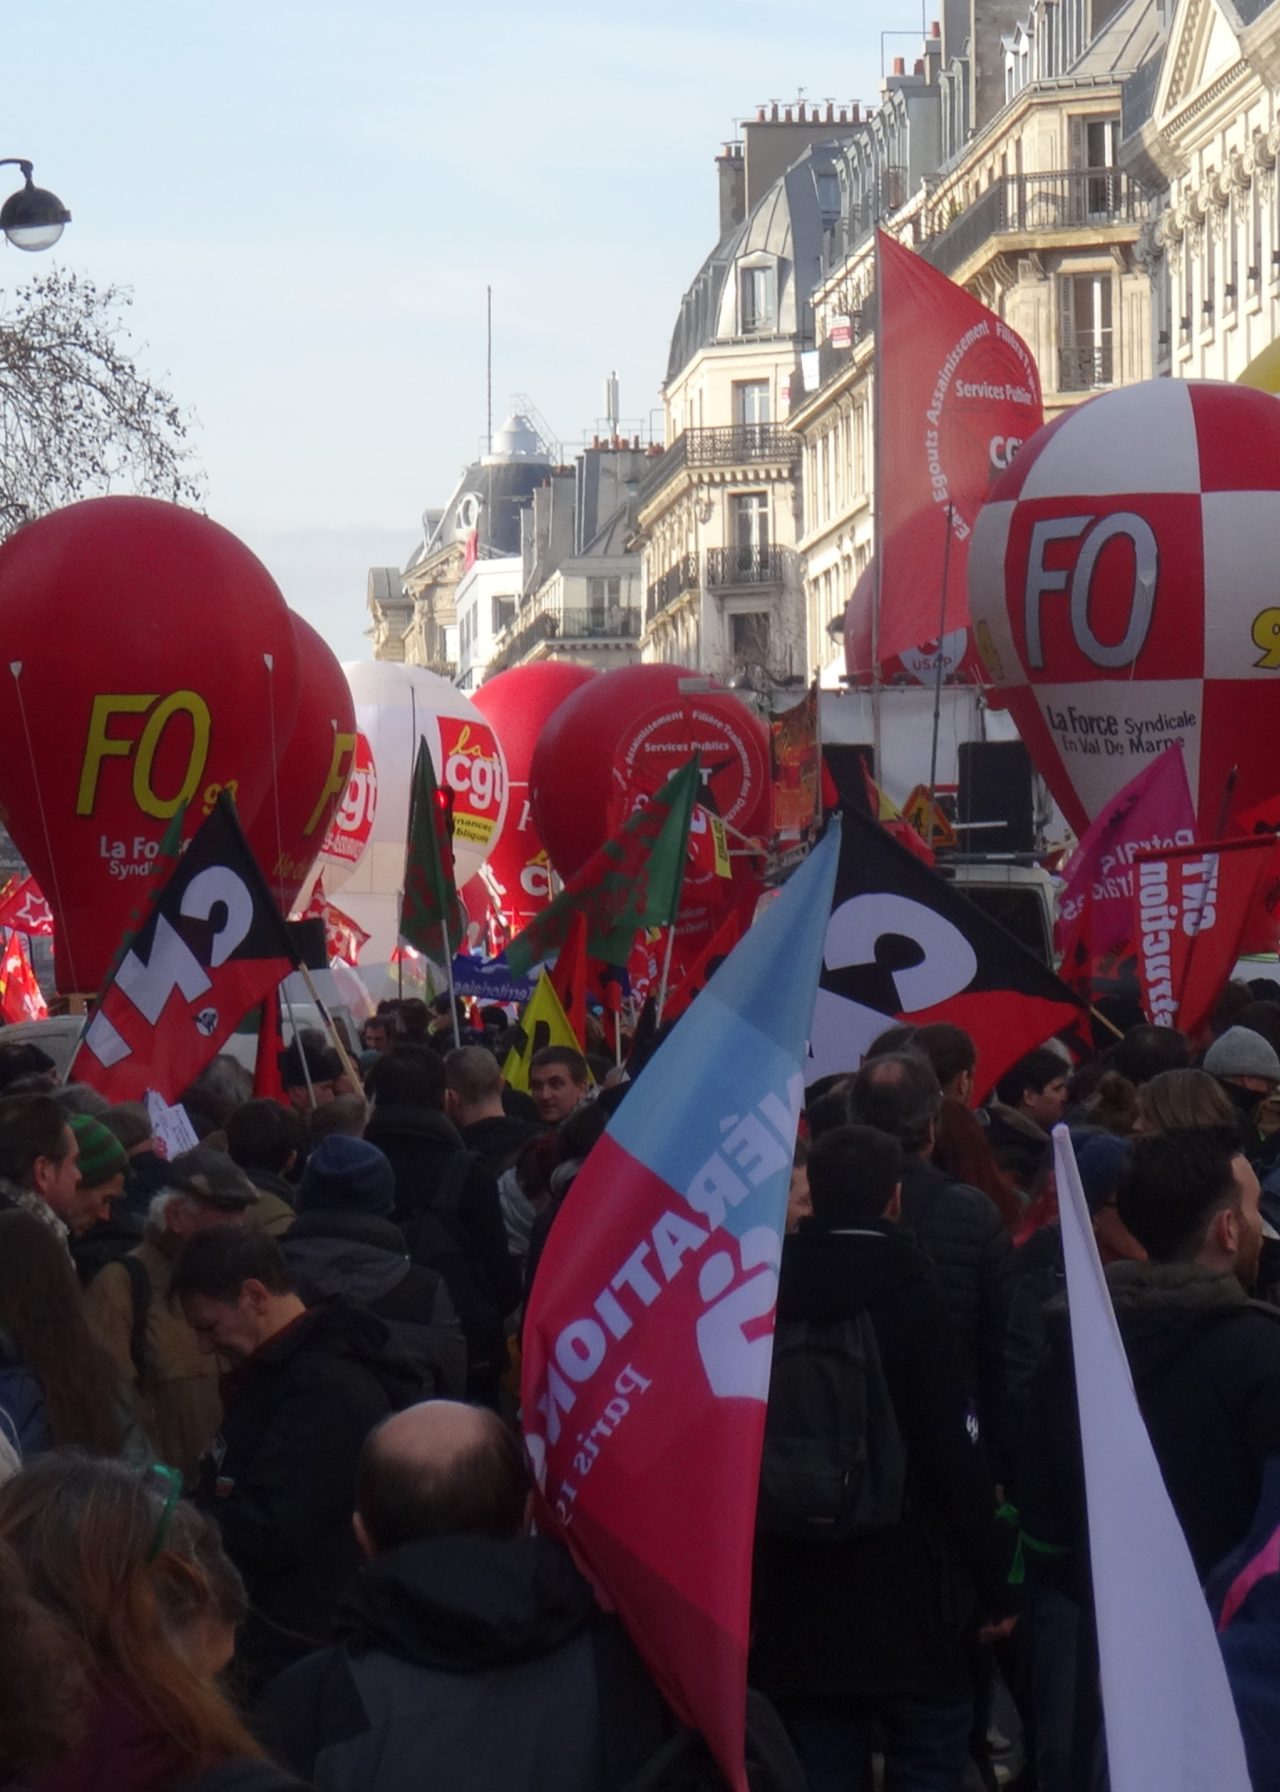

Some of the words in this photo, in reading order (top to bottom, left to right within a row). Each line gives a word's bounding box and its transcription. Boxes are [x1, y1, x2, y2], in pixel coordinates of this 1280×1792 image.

[955, 379, 1005, 401] Services
[1024, 511, 1160, 671] FO
[1047, 703, 1069, 732] La
[1068, 706, 1119, 735] Force
[1125, 709, 1197, 736] Syndicale
[76, 689, 212, 820] FO
[644, 742, 689, 753] Services
[1079, 736, 1101, 755] Val
[1105, 737, 1124, 757] De
[335, 760, 378, 832] gt
[446, 751, 503, 810] cgt
[100, 835, 126, 859] La
